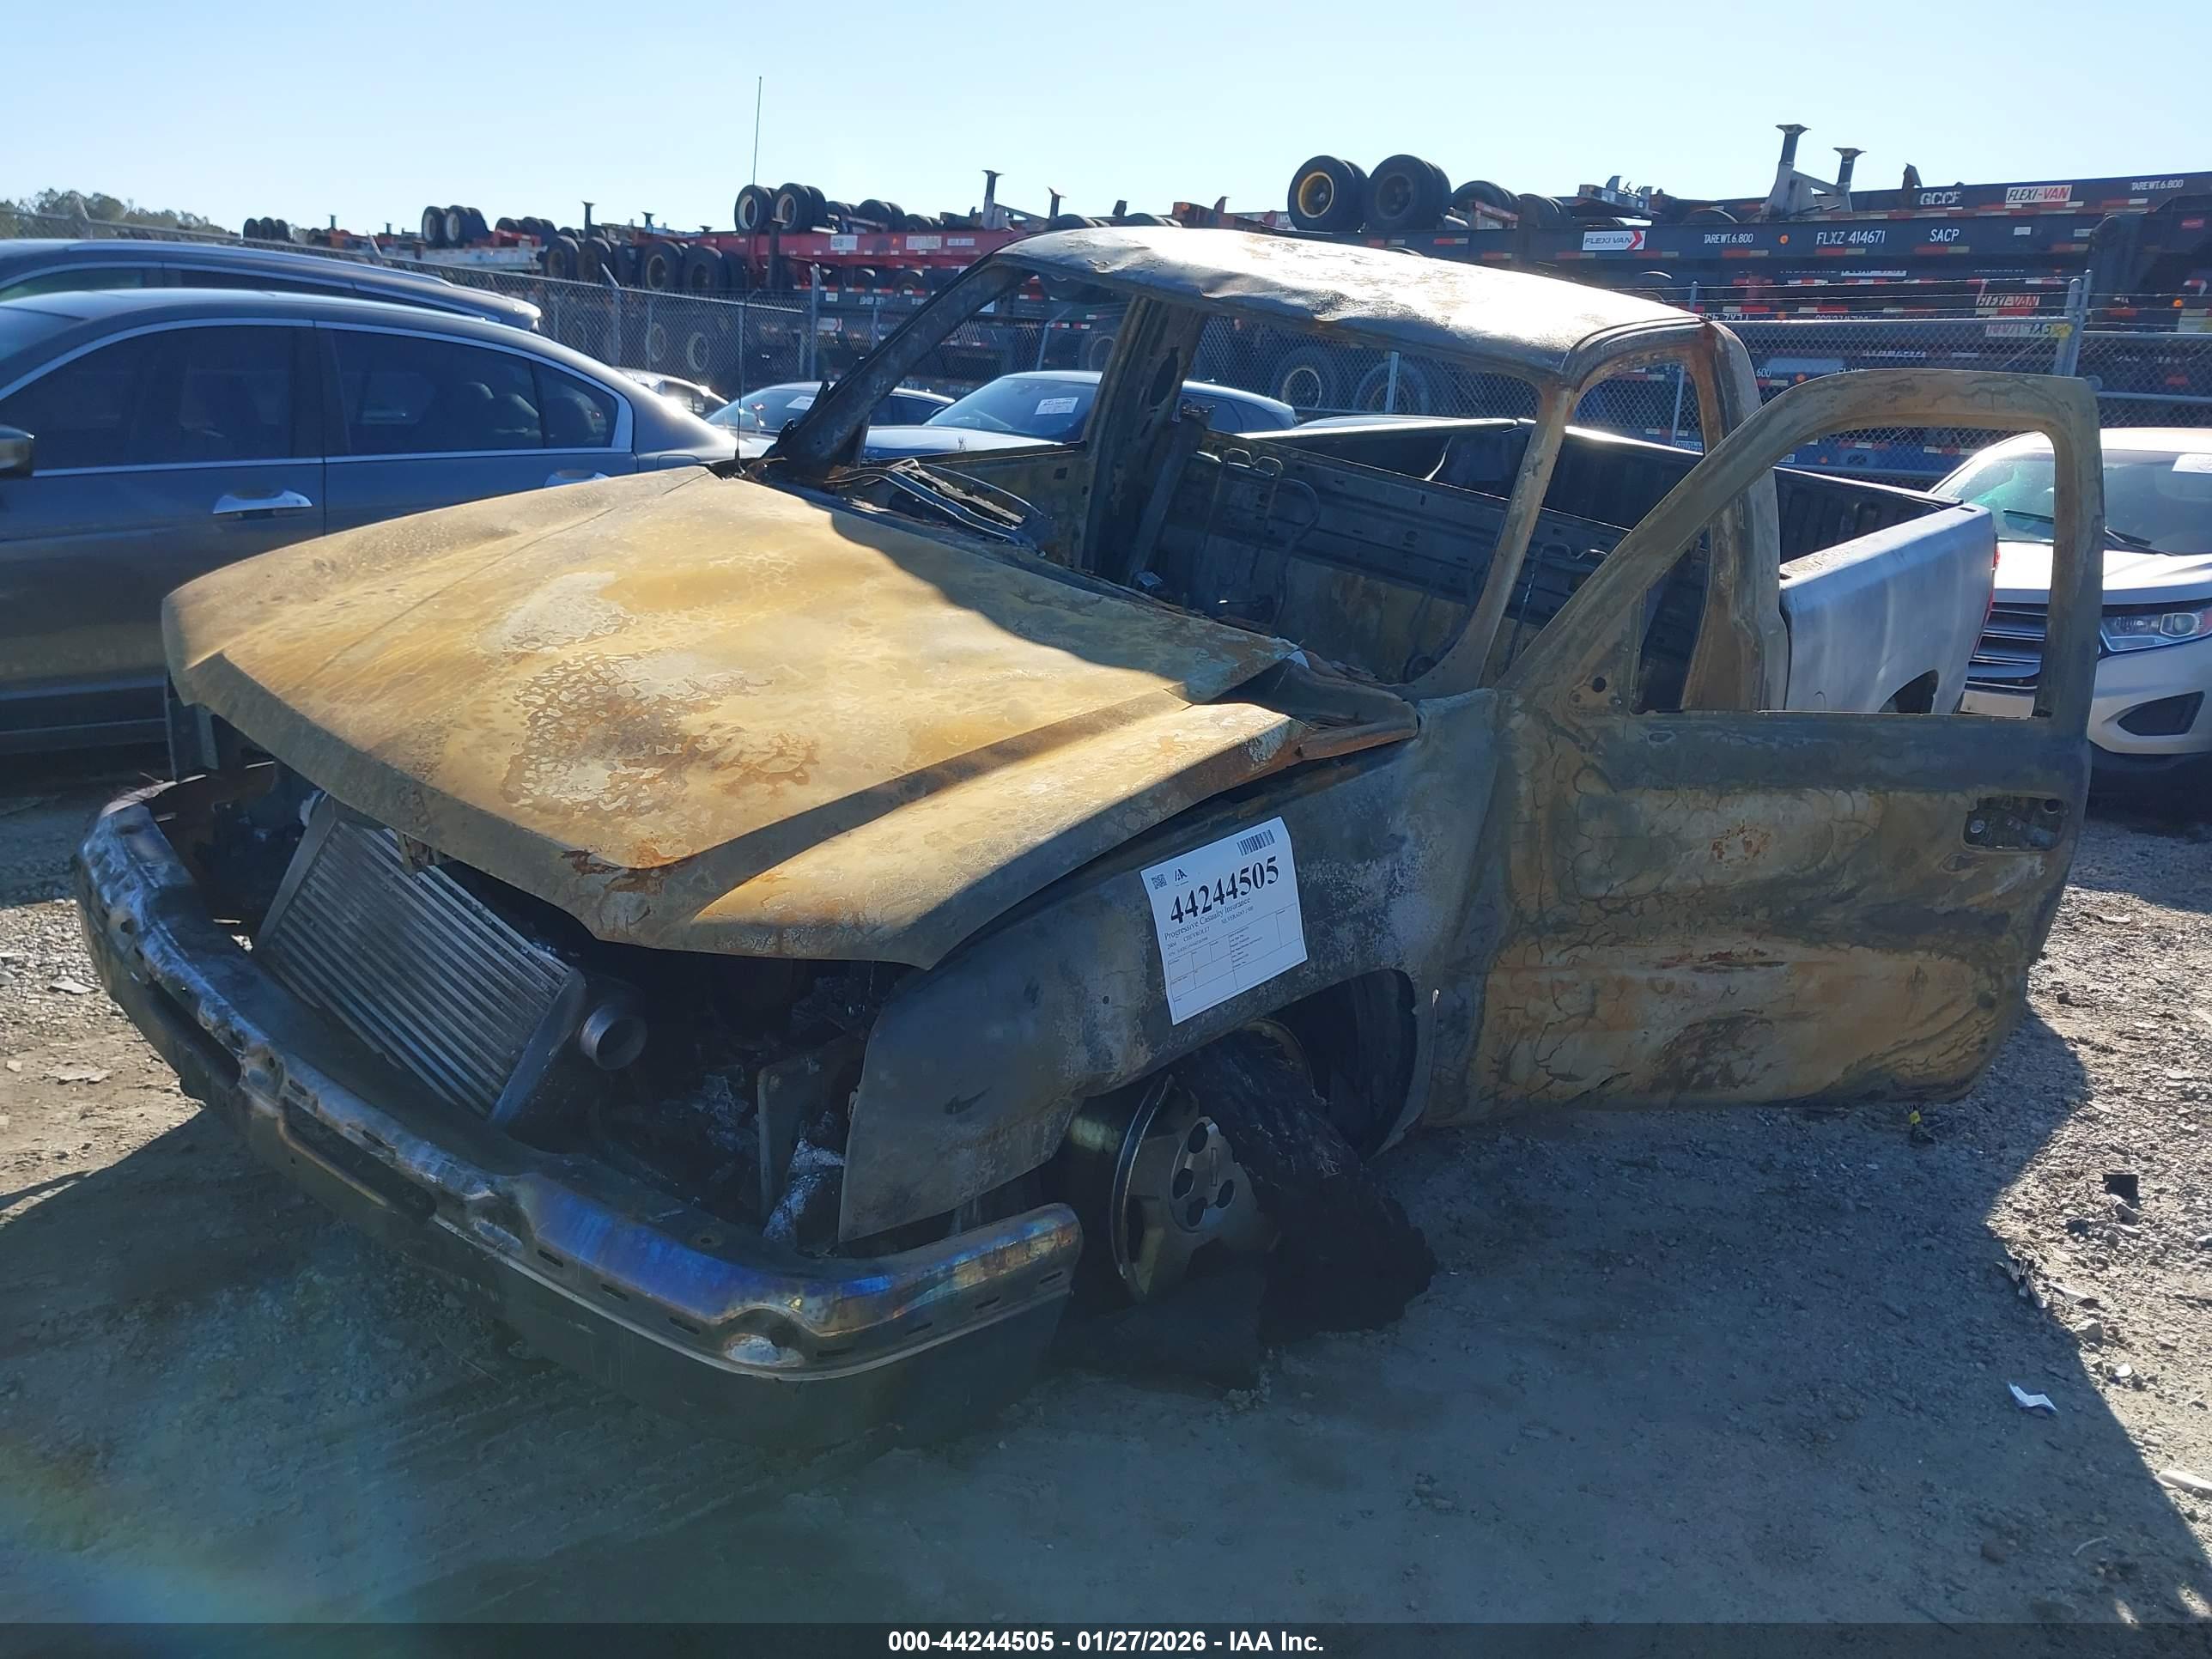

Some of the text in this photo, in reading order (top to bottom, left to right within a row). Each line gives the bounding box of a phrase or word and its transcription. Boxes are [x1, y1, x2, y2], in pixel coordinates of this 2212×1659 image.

[2007, 186, 2070, 201] FLEXI-VAN
[1815, 229, 1887, 245] FLXZ 414671
[1929, 228, 1960, 242] SACP
[1170, 855, 1279, 924] 44244505
[1164, 897, 1251, 941] Progressive Casualty Insurance
